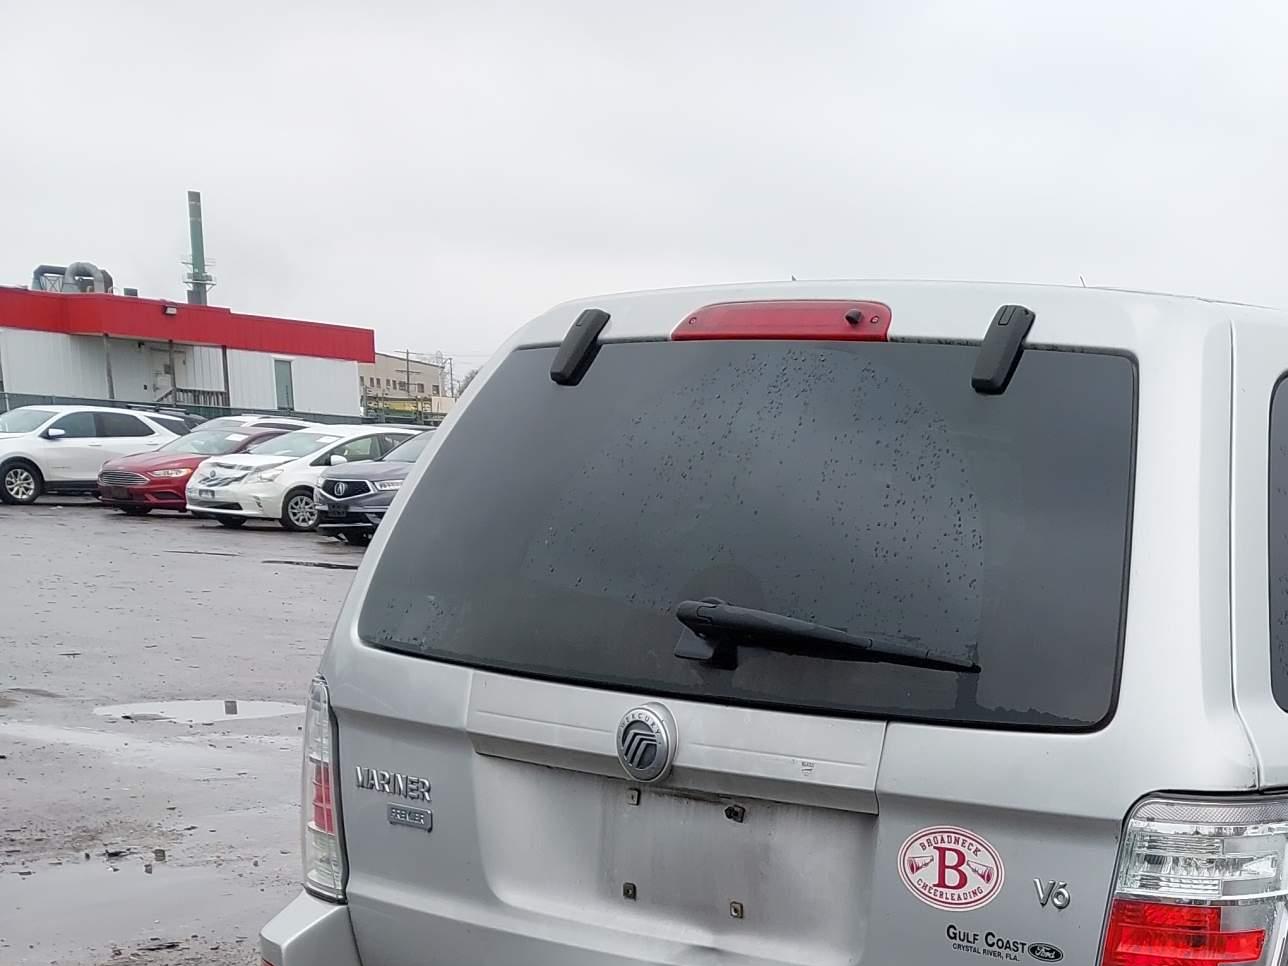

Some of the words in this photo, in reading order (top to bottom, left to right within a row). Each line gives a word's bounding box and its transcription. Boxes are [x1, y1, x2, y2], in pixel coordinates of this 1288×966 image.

[919, 834, 982, 857] BROADNECK
[933, 845, 969, 891] B
[916, 878, 984, 902] CHEERLEADING
[1033, 877, 1071, 910] V6
[952, 942, 981, 955] CRYSTAL
[982, 948, 1004, 961] RIVER,
